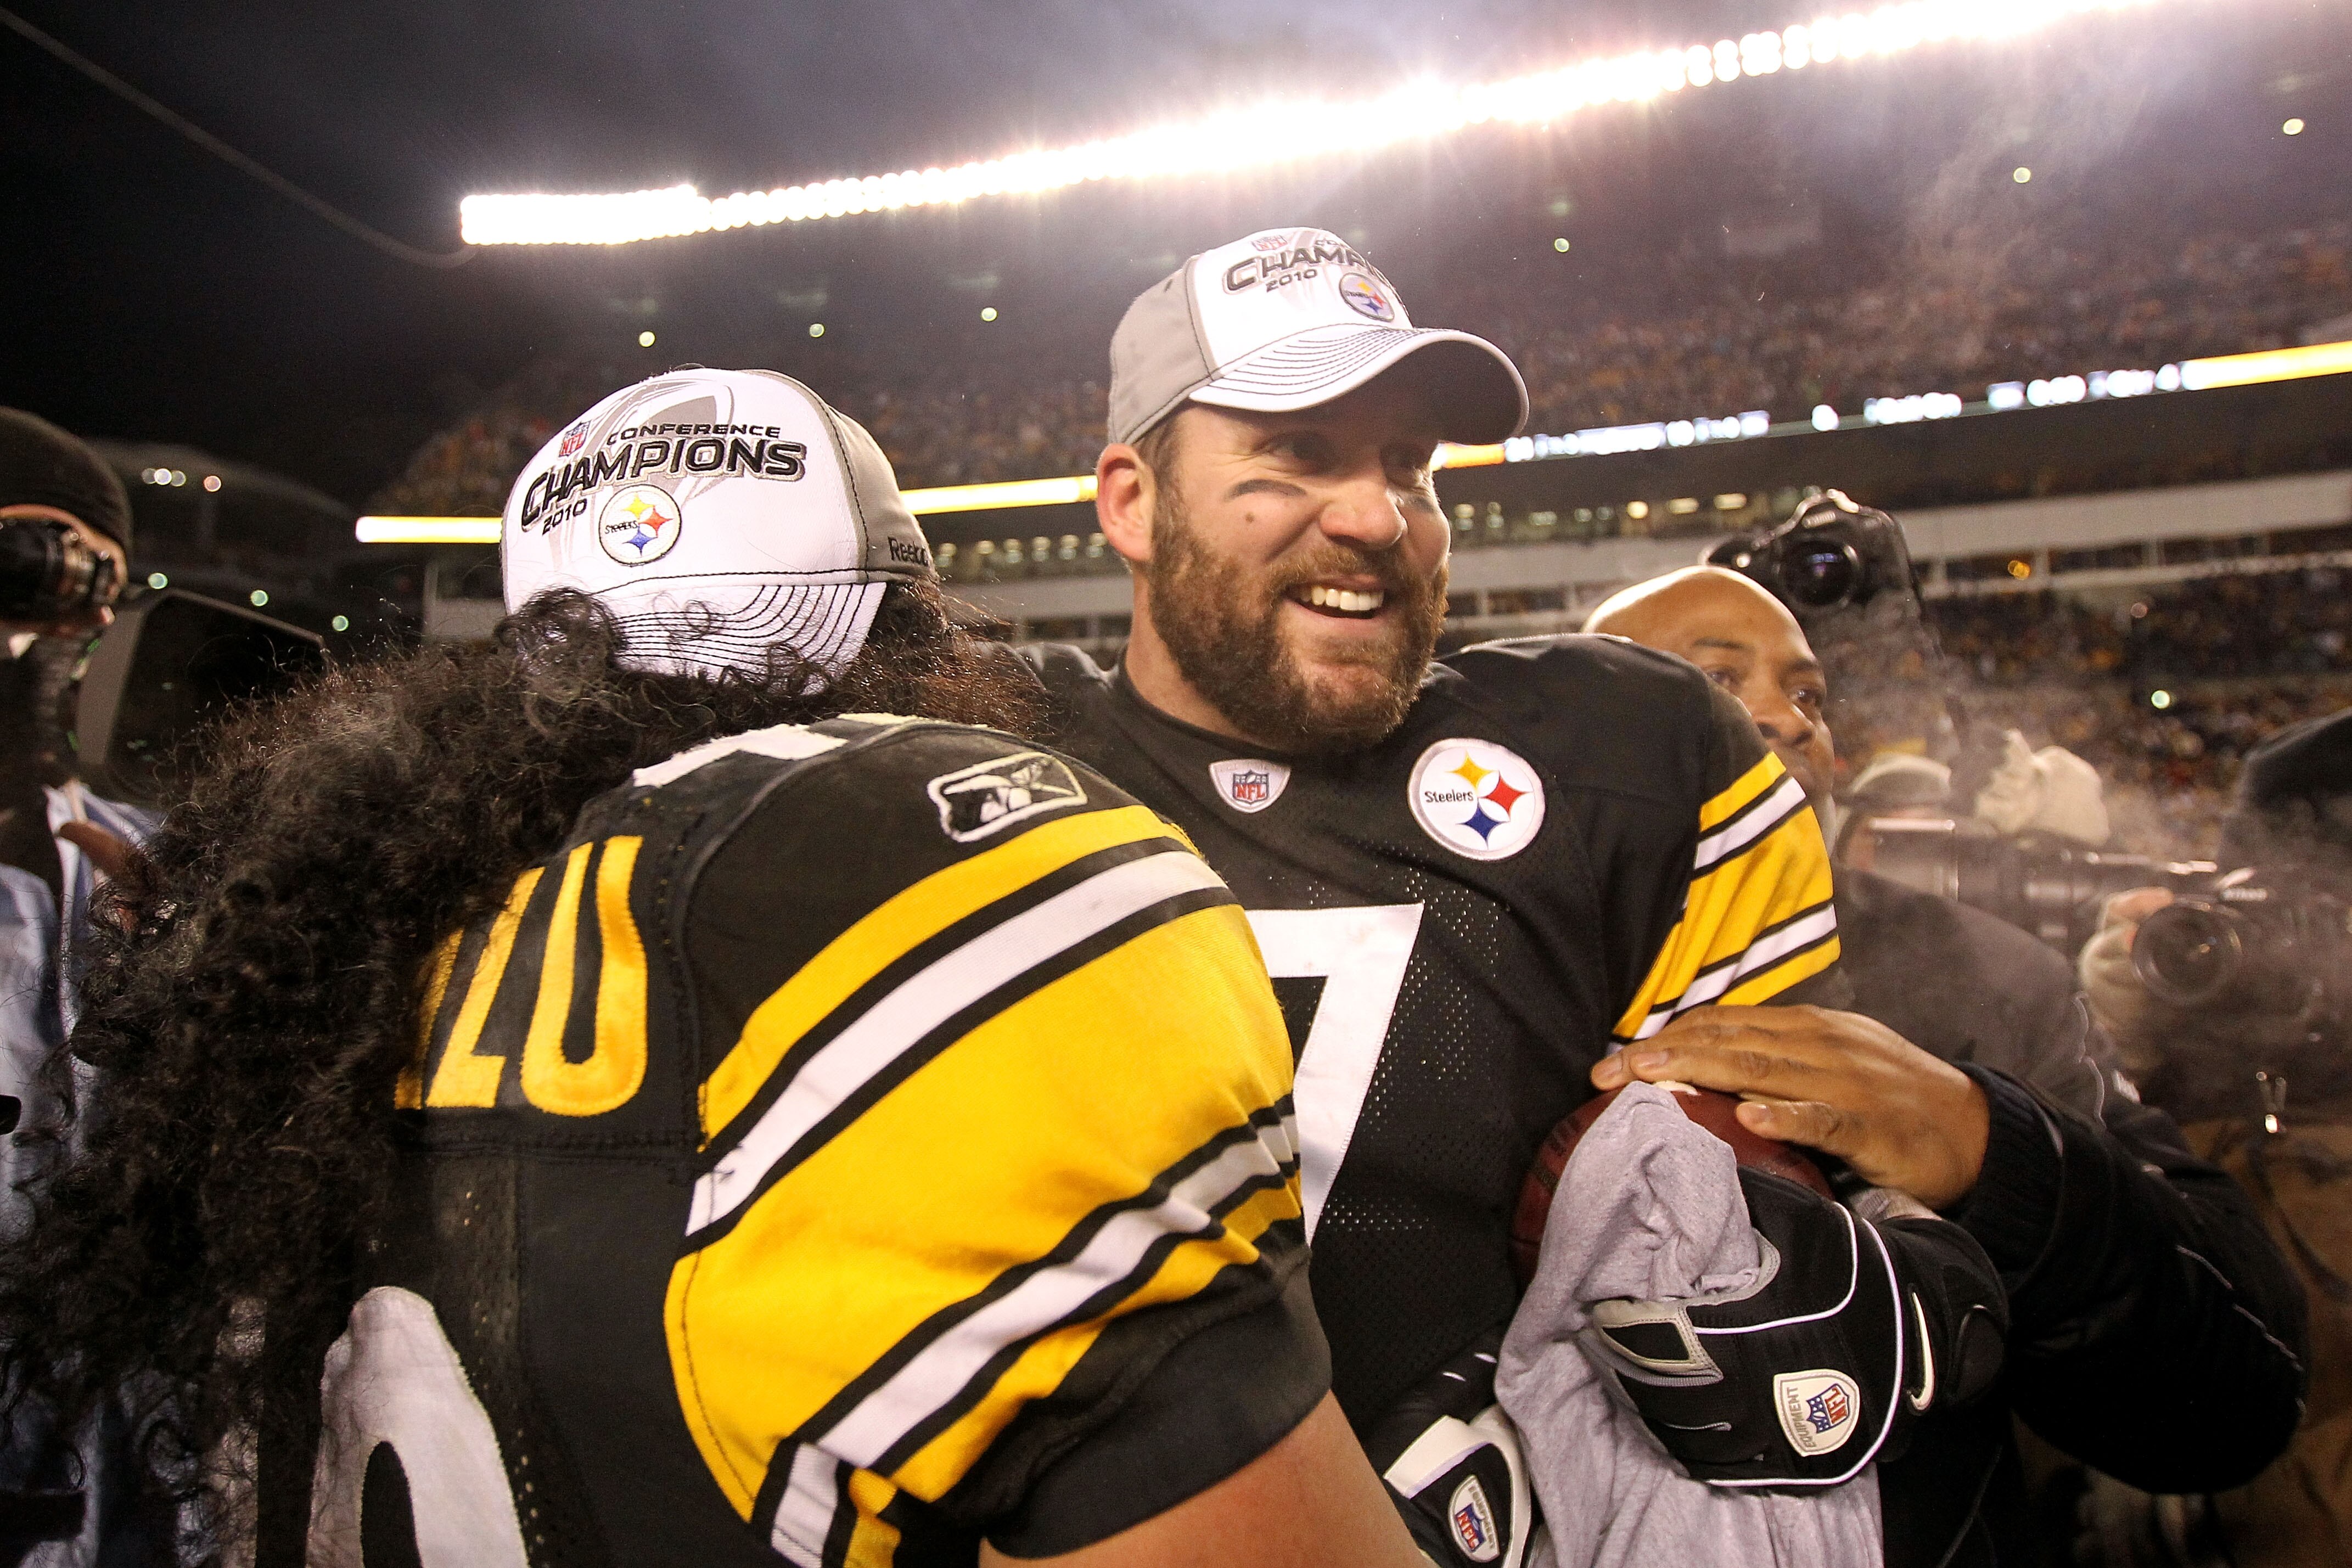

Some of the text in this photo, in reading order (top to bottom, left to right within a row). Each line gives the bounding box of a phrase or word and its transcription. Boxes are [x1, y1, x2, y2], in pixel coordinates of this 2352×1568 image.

[1266, 268, 1318, 293] 2010
[559, 432, 583, 457] NFL
[607, 423, 782, 446] CONFERENCE
[521, 438, 803, 526] CHAMPIONS
[542, 498, 587, 535] 2010
[604, 520, 637, 534] Steelers
[887, 535, 929, 567] Reebo
[1235, 783, 1266, 800] NFL
[1424, 789, 1474, 803] Steelers
[1243, 903, 1425, 1247] 7
[1787, 1386, 1817, 1448] EQUIPMENT
[1824, 1386, 1849, 1425] NFL
[1457, 1511, 1479, 1550] NFL
